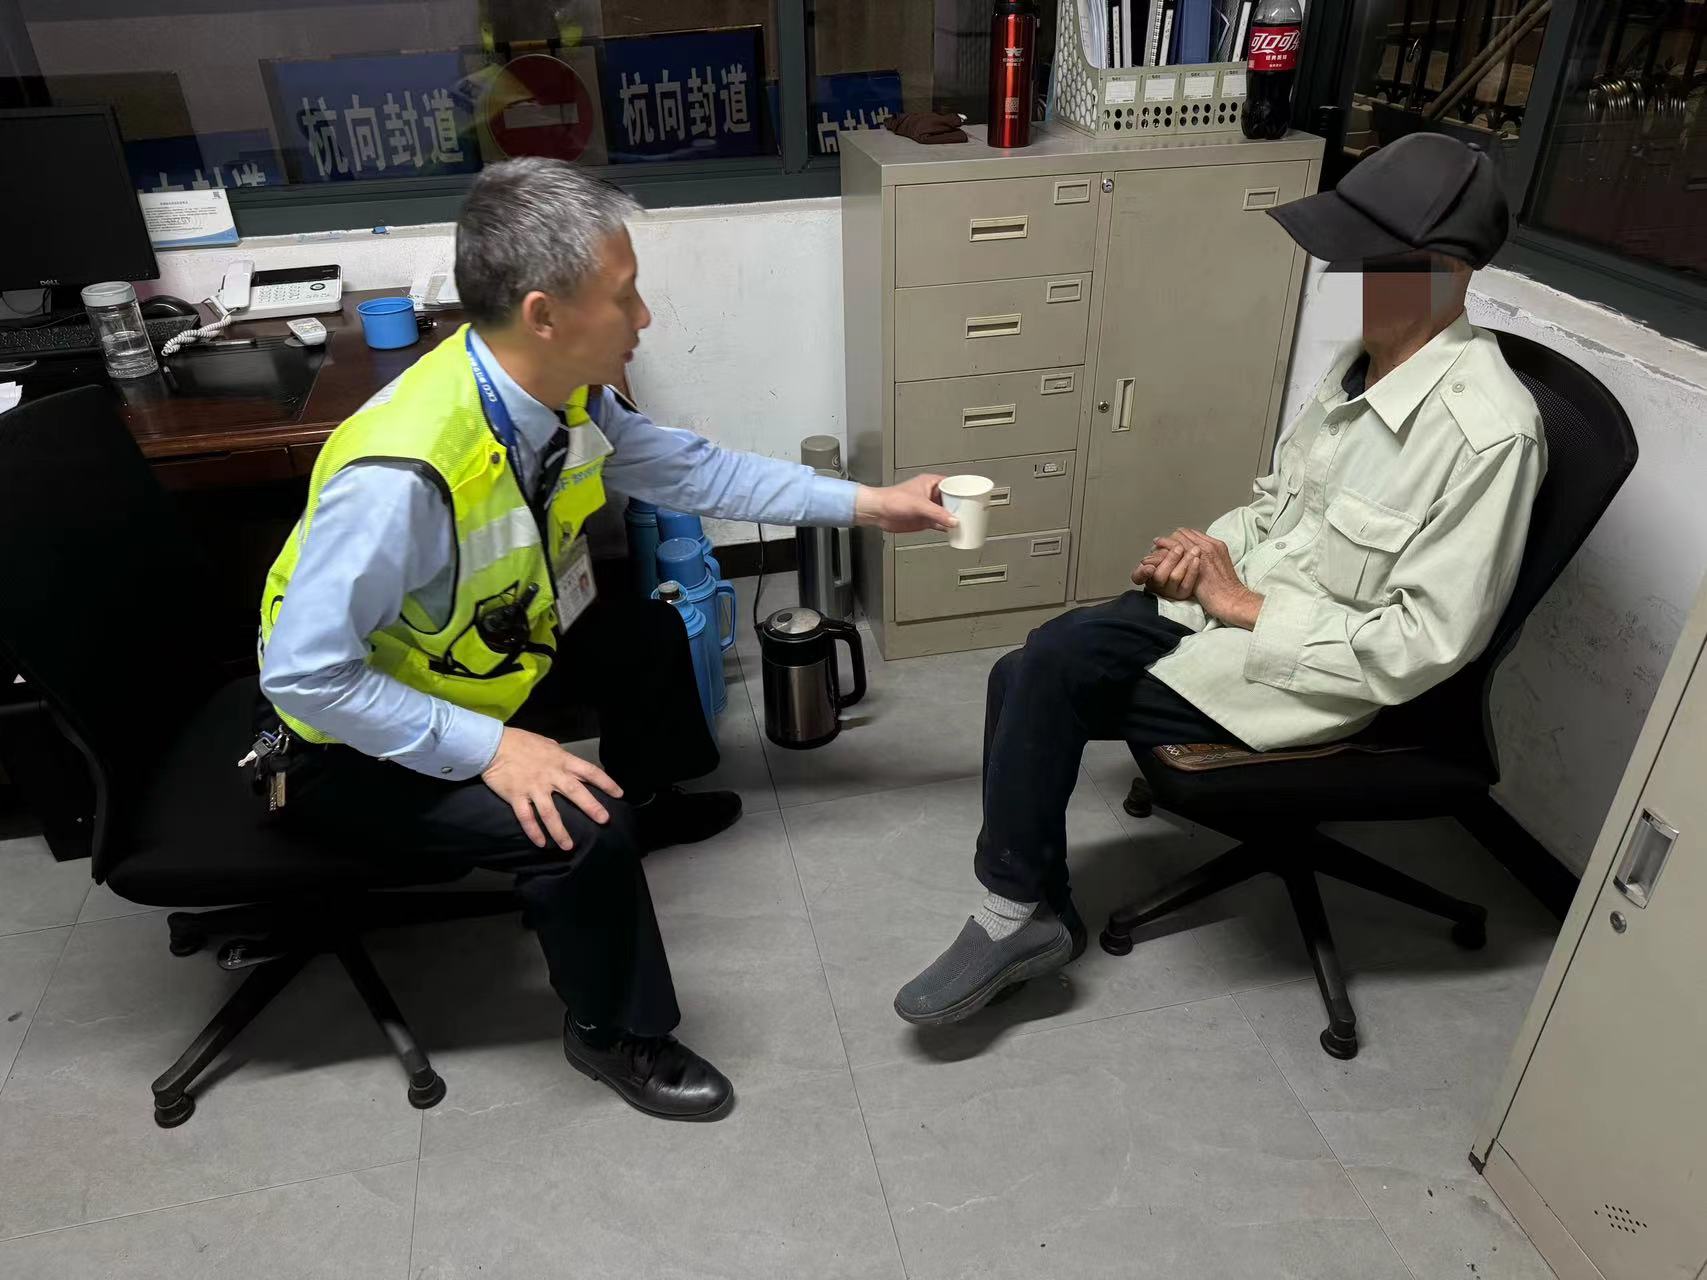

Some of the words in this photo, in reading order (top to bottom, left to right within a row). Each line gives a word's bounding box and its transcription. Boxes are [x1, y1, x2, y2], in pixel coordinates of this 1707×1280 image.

[302, 88, 464, 176] 杭向封道
[620, 64, 750, 145] 杭向封道
